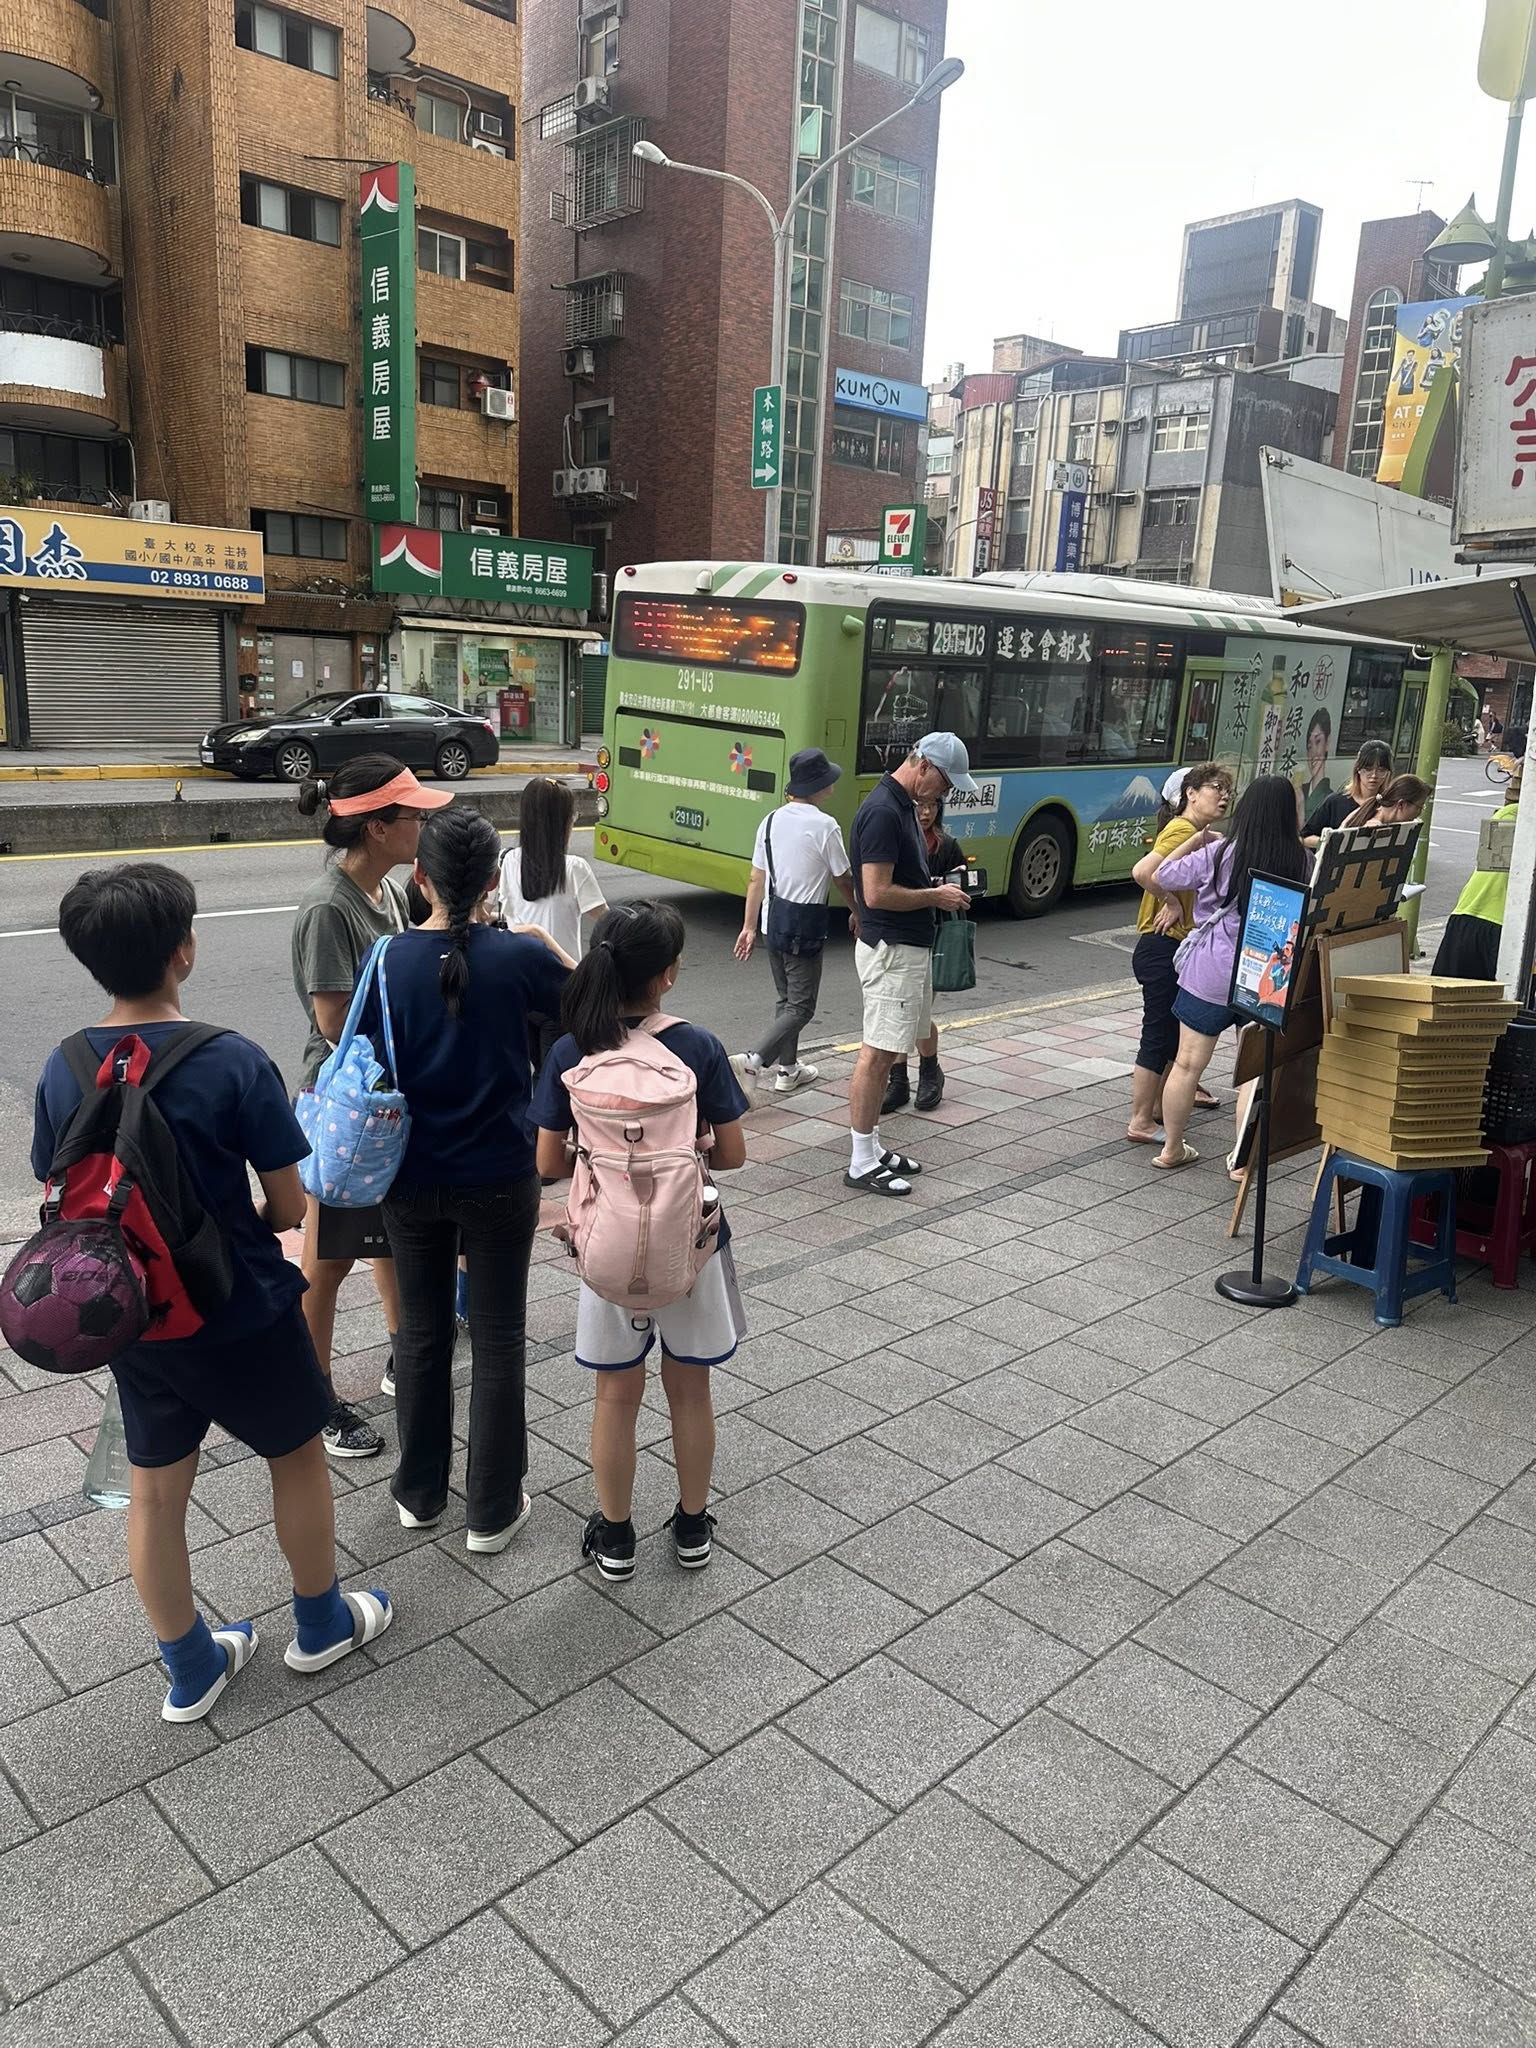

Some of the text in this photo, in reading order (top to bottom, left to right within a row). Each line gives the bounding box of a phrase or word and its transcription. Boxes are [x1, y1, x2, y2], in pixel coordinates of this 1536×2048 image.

[370, 266, 391, 440] 信義房屋
[836, 377, 901, 406] KUMON
[760, 391, 775, 459] 木柵路
[1393, 405, 1411, 419] AT
[125, 550, 248, 572] 國小/國中/高中 權威
[144, 537, 248, 559] 臺大校友 主持
[469, 547, 568, 585] 信義房屋
[150, 570, 249, 590] 02 8931 0688
[677, 668, 714, 693] 291-U3
[1314, 660, 1333, 697] 新
[1280, 660, 1311, 779] 和綠茶
[949, 784, 996, 810] 御茶園
[675, 809, 702, 827] 291-U3
[1088, 816, 1148, 853] 和綠茶
